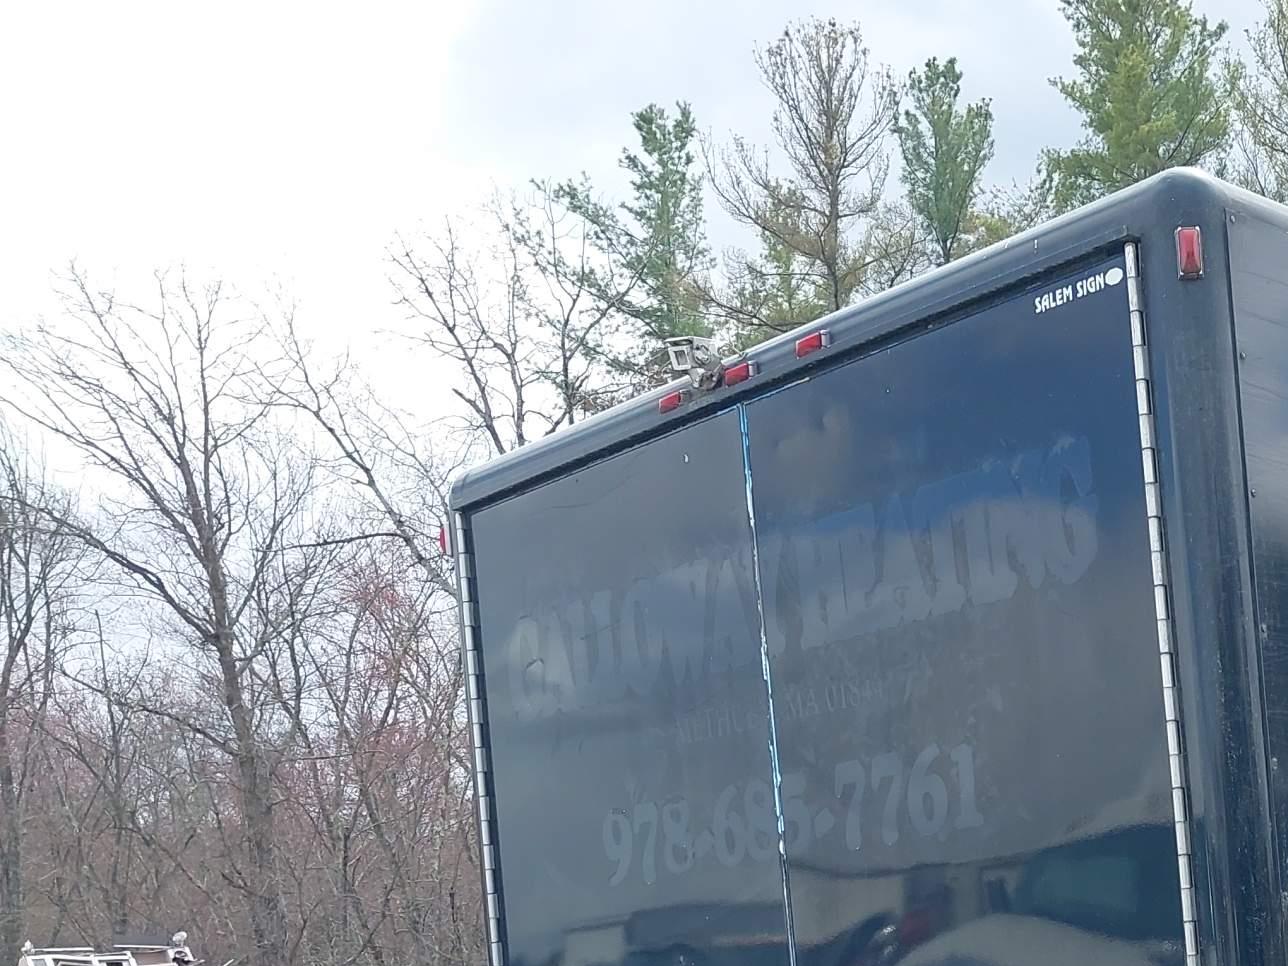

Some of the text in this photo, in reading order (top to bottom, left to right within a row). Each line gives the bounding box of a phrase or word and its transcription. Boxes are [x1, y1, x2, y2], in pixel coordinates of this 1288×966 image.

[1035, 272, 1105, 313] SALEM SIGN
[602, 743, 984, 887] 978-685-7761
